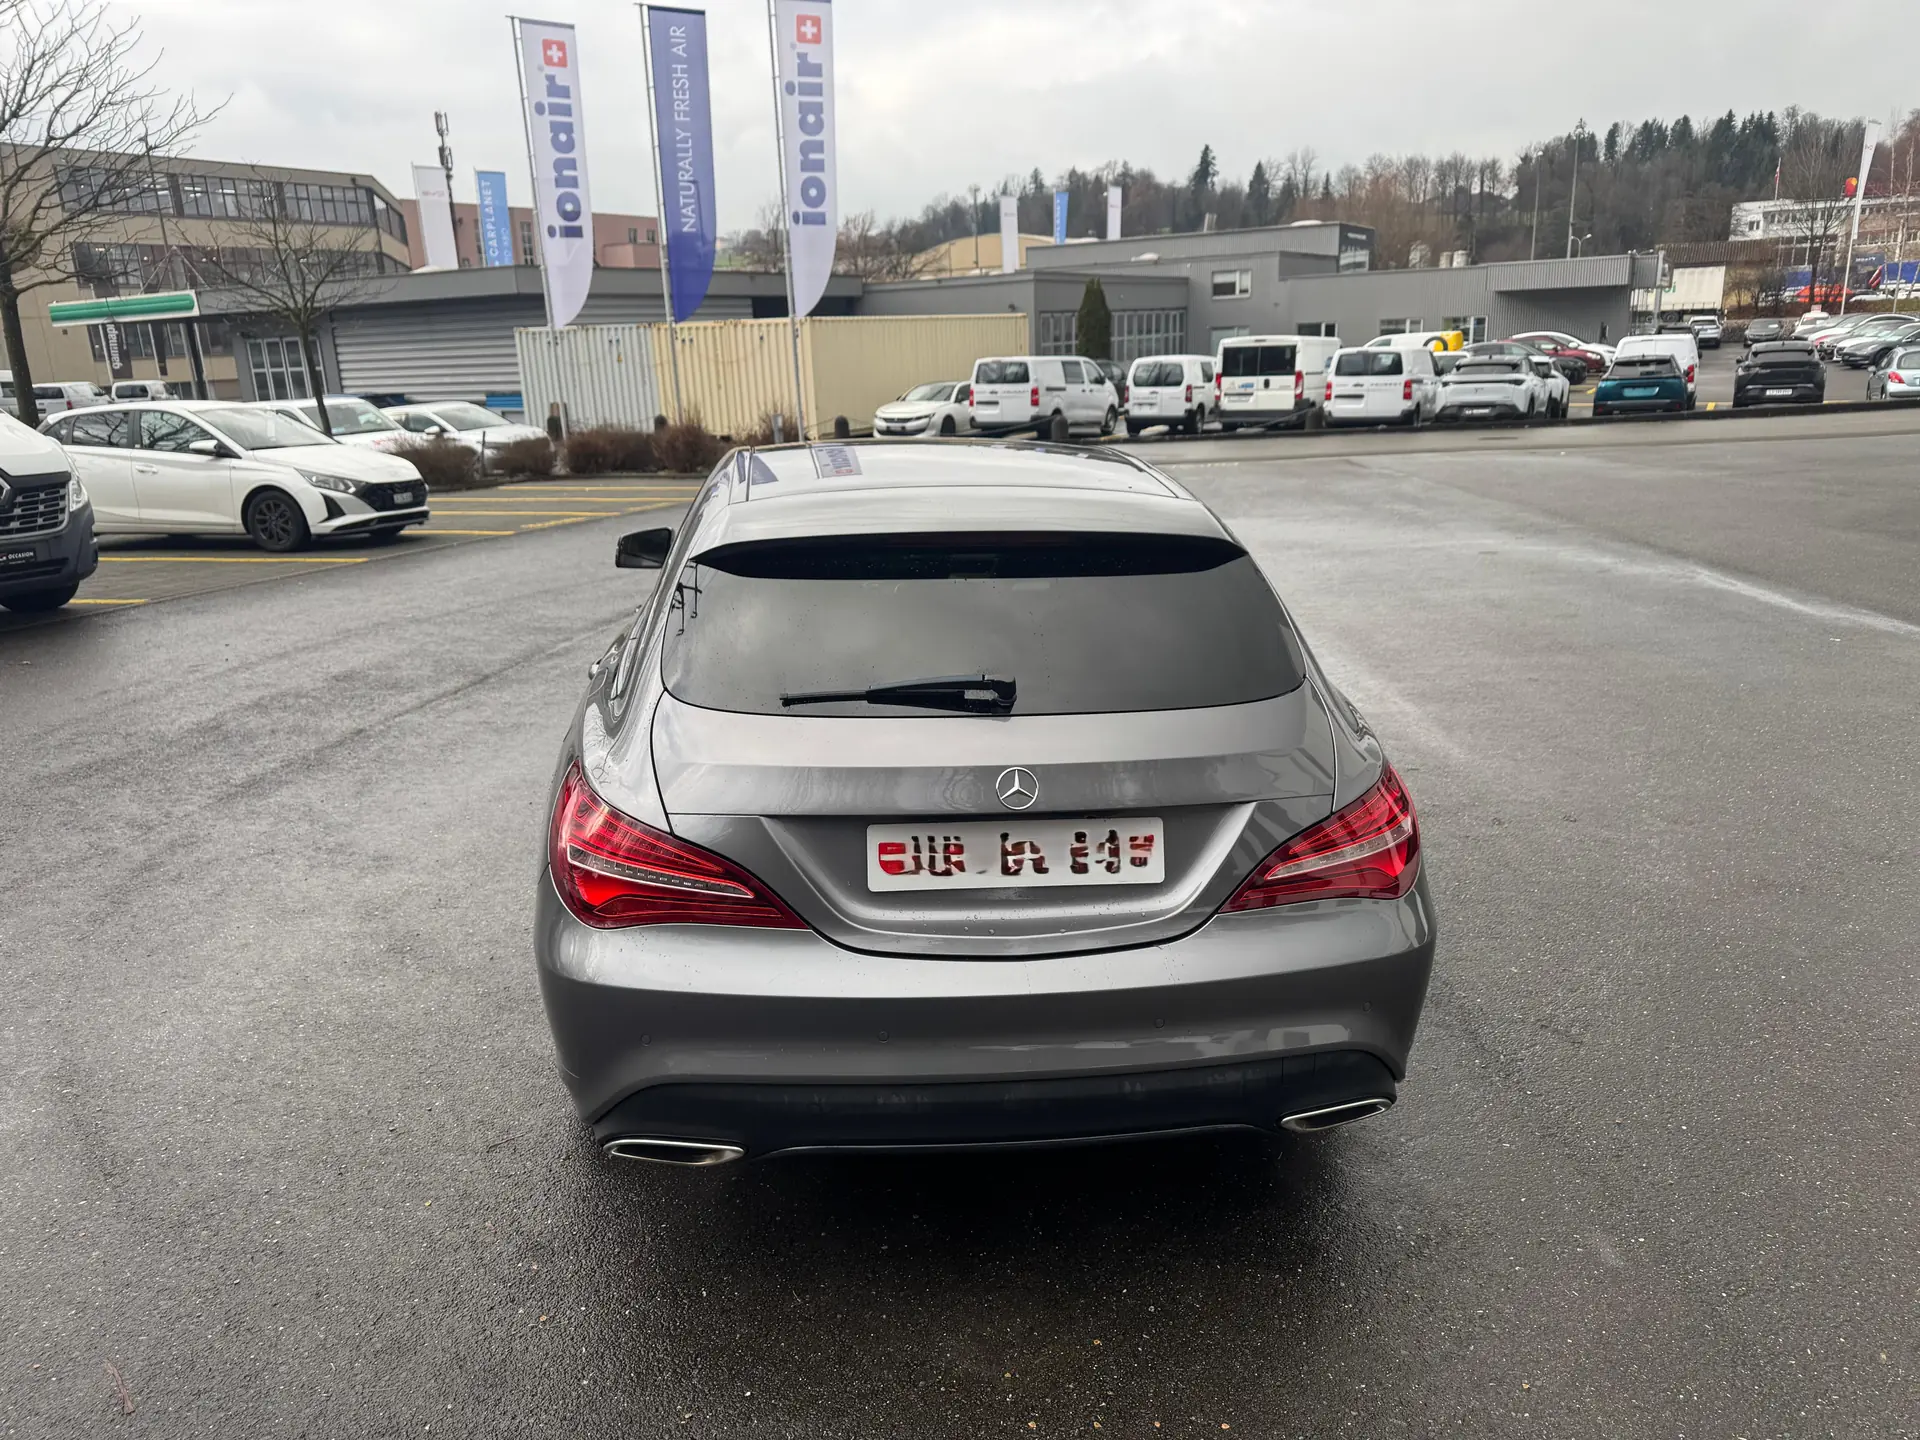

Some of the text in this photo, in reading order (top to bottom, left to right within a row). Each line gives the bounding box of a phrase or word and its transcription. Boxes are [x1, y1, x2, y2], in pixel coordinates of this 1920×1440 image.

[534, 73, 584, 239] ionair
[669, 25, 697, 232] NATURALLY FRESH AIR
[785, 52, 827, 226] ionair
[481, 180, 499, 257] CARPLANET
[8, 551, 34, 560] OCCASION
